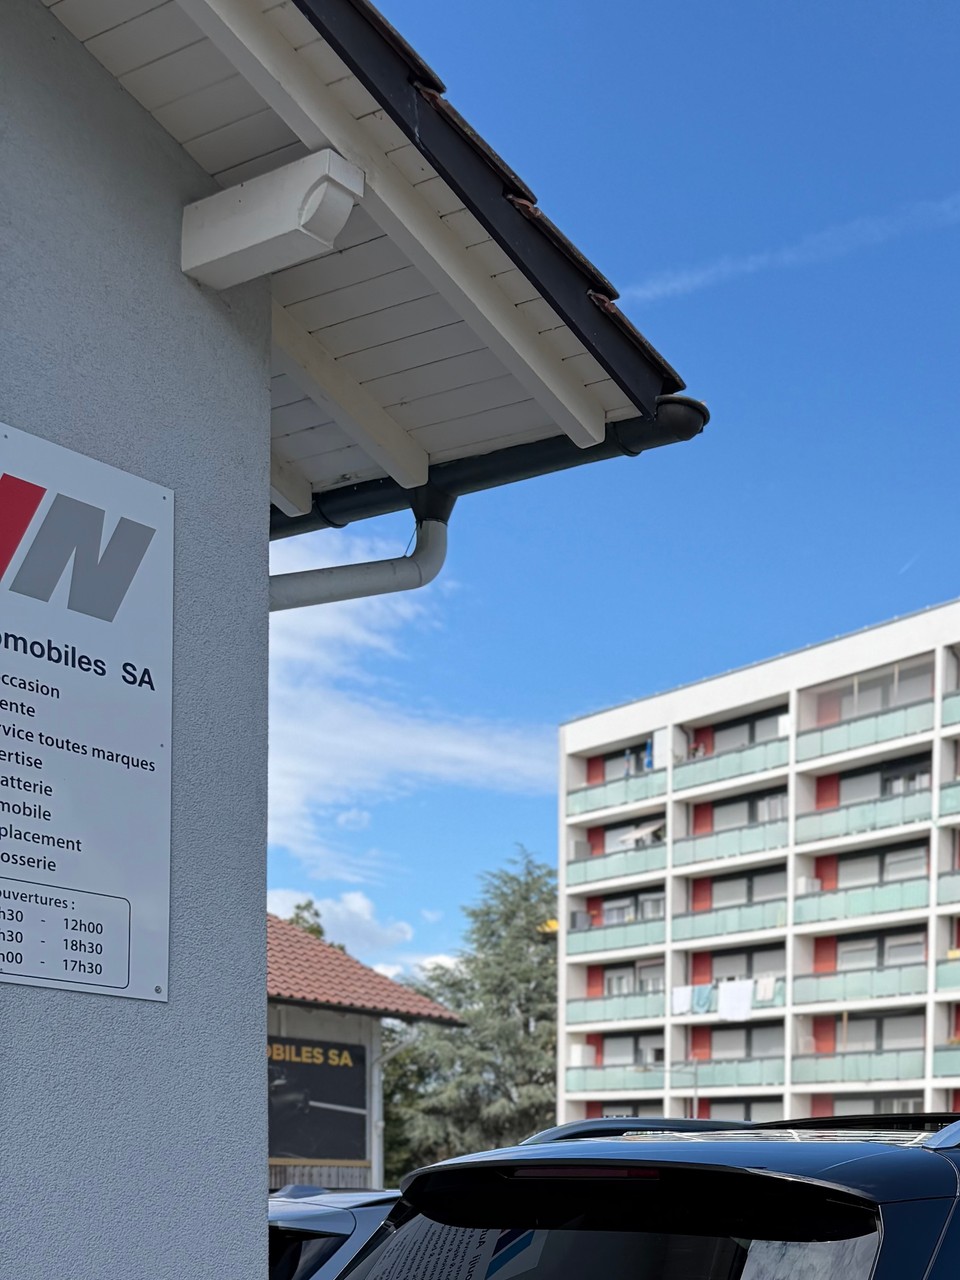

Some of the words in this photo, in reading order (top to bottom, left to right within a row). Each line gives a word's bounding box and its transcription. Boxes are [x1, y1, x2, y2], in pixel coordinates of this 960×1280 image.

[0, 632, 107, 676] mobiles
[122, 662, 155, 691] SA
[2, 674, 60, 699] ccasion
[0, 699, 35, 718] ente
[0, 724, 34, 742] vice
[38, 732, 88, 756] toutes
[92, 746, 156, 772] marques
[0, 750, 43, 770] ertise
[0, 776, 53, 797] atterie
[0, 852, 57, 872] osserie
[0, 889, 68, 910] uvertures
[63, 918, 103, 935] 12h00
[63, 938, 103, 955] 18h30
[62, 959, 103, 975] 17h30
[328, 1049, 353, 1067] SA
